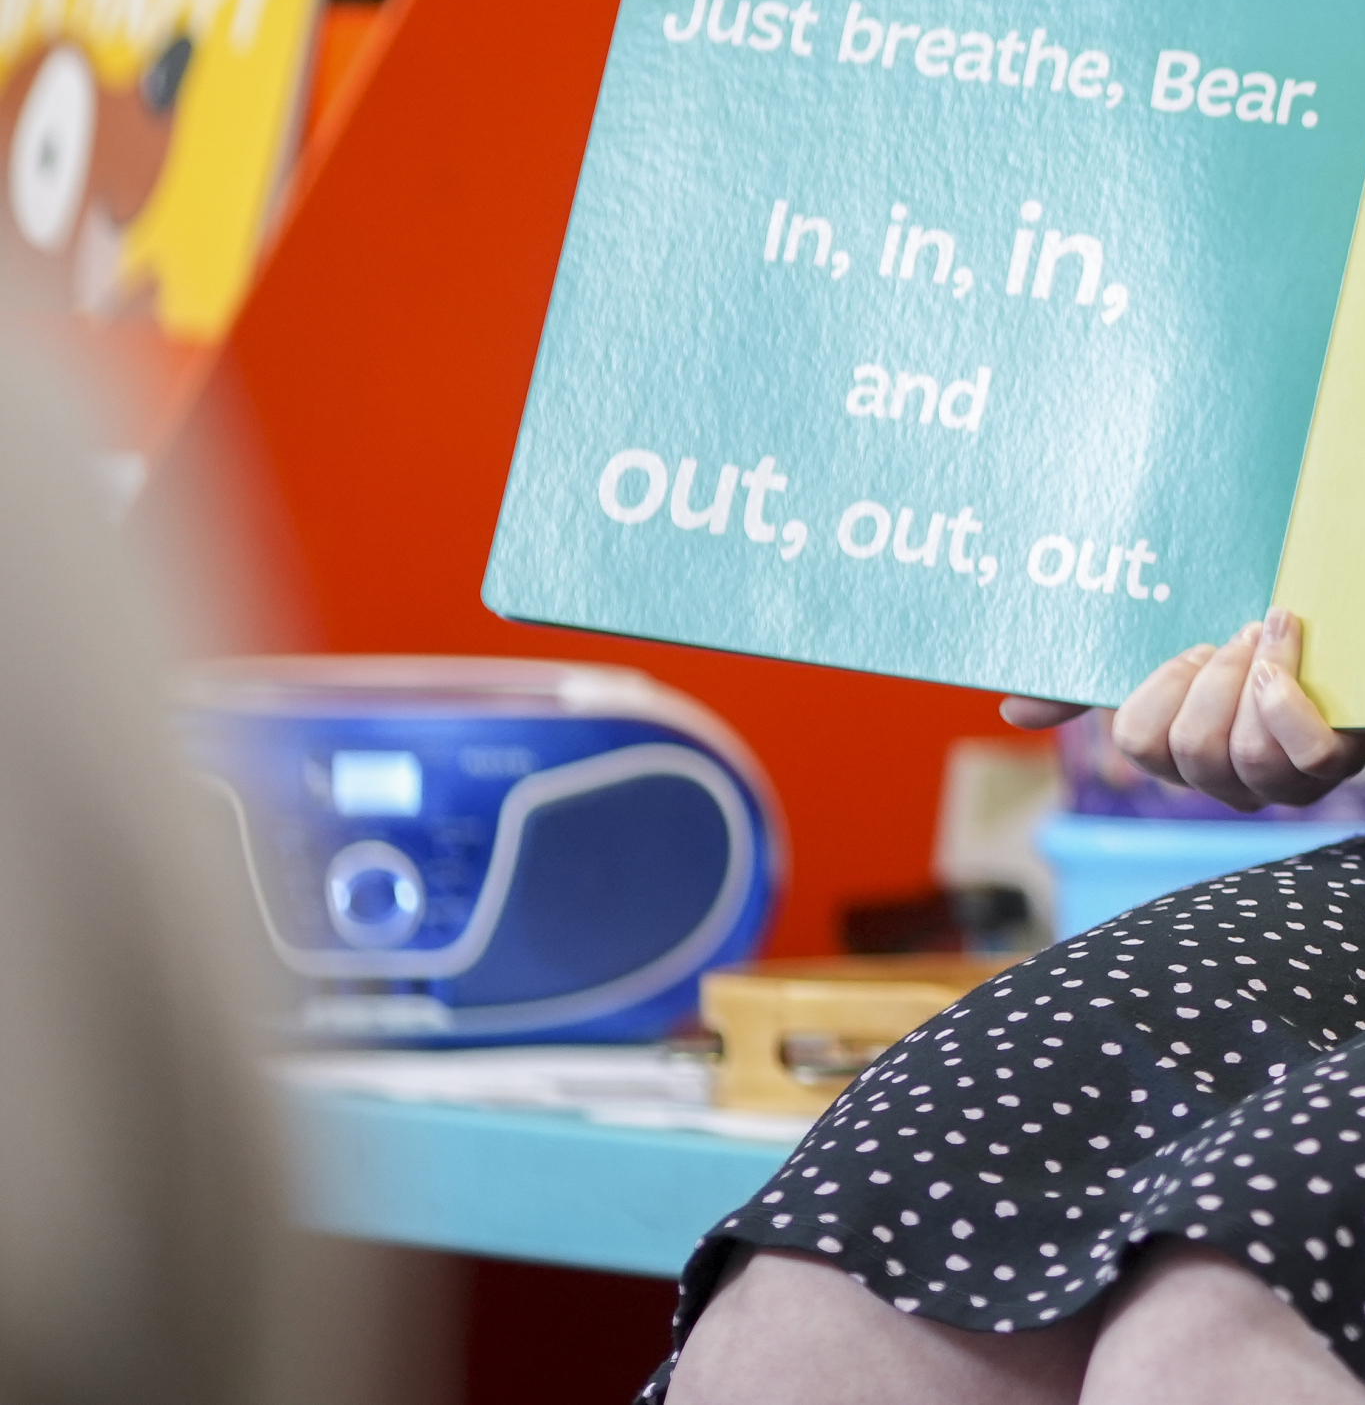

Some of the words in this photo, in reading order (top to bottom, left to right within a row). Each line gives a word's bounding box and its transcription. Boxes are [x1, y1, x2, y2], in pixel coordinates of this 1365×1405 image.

[837, 0, 1127, 111] breathe,
[1149, 48, 1320, 129] Bear.
[762, 198, 852, 280] In,
[877, 202, 974, 300] in,
[1004, 199, 1131, 325] in,
[844, 362, 992, 433] and
[598, 447, 810, 562] out,
[835, 499, 1000, 590] out,
[1026, 531, 1172, 603] out.
